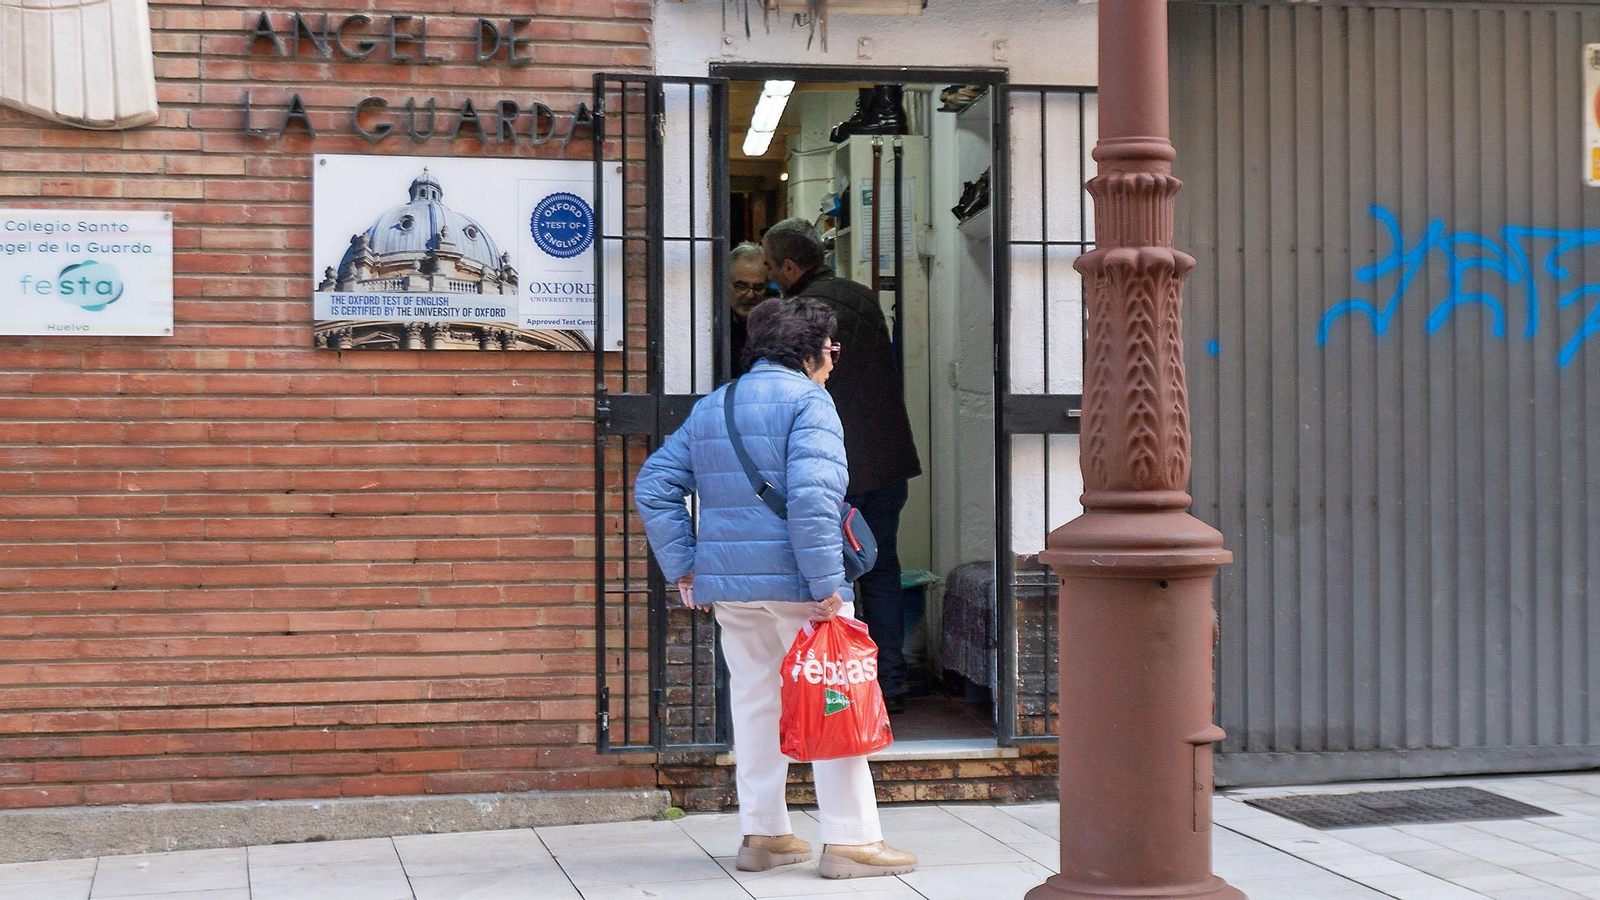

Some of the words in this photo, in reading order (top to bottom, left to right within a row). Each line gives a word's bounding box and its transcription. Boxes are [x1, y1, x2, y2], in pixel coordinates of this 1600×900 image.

[247, 11, 444, 60] ANGEL
[476, 18, 532, 65] DE
[244, 91, 317, 139] LA
[353, 97, 595, 147] GUARDA
[545, 203, 583, 218] OXFORD
[5, 220, 72, 235] Colegio
[77, 221, 130, 233] Santo
[544, 232, 583, 248] ENGLISH
[38, 242, 59, 253] de
[66, 242, 81, 253] la
[87, 242, 152, 254] Guarda
[20, 274, 114, 296] festa
[529, 282, 595, 295] OXFORD
[331, 295, 346, 305] THE
[348, 295, 380, 306] OXFORD
[382, 296, 401, 306] TEST
[403, 296, 414, 306] OF
[416, 296, 449, 306] ENGLISH
[331, 306, 340, 316] IS
[341, 306, 382, 316] CERTIFIED
[384, 307, 395, 316] BY
[397, 307, 412, 317] THE
[414, 307, 460, 317] UNIVERSITY
[462, 308, 472, 317] OF
[474, 308, 506, 318] OXFORD
[527, 318, 561, 326] Approved
